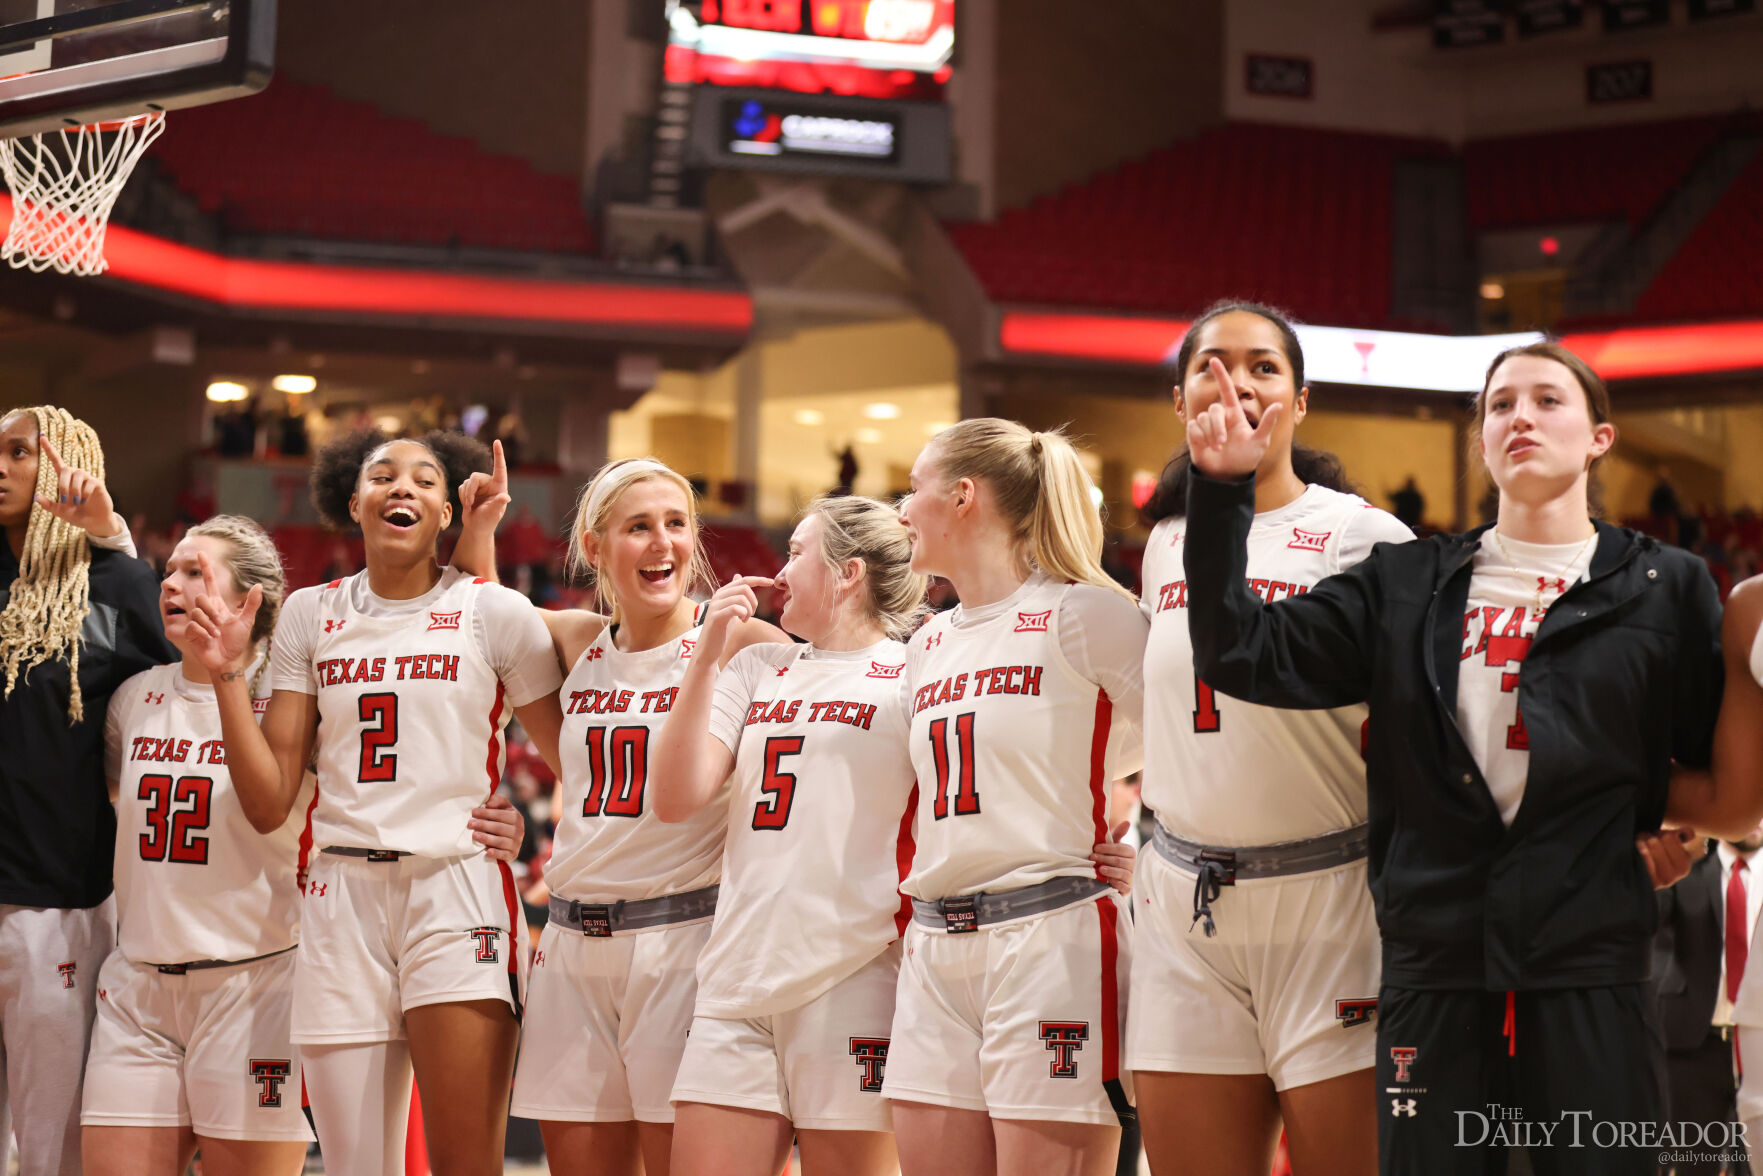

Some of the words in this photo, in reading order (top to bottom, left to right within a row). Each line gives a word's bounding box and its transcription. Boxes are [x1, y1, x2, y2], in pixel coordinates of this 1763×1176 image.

[1156, 579, 1188, 613] TEX
[317, 657, 386, 688] TEXAS
[395, 654, 460, 682] TECH
[912, 672, 968, 718] TEXAS
[974, 665, 1043, 696] TECH
[567, 688, 635, 714] TEXAS
[640, 686, 681, 713] TE
[745, 699, 803, 726] EXAS
[808, 700, 877, 731] TECH
[131, 736, 192, 762] TEXAS
[197, 740, 228, 765] TE
[357, 691, 398, 783] 2
[582, 725, 650, 818] 10
[752, 735, 806, 831] 5
[929, 711, 981, 821] 11
[138, 773, 213, 865] 32
